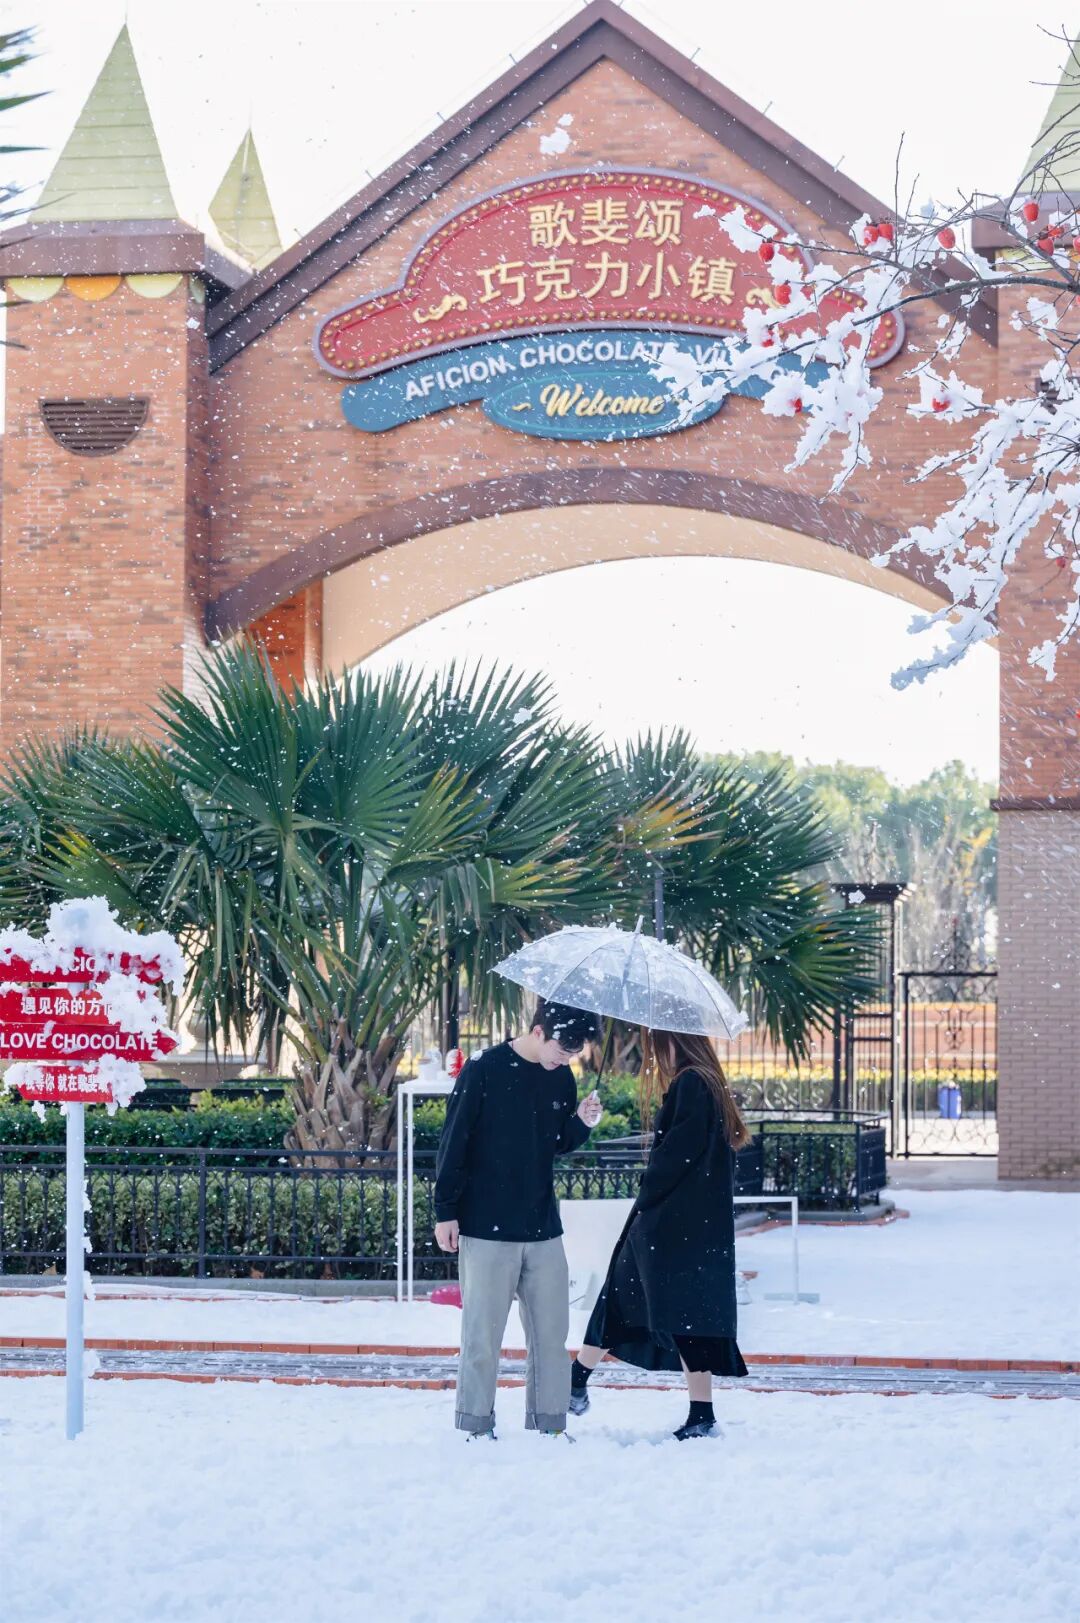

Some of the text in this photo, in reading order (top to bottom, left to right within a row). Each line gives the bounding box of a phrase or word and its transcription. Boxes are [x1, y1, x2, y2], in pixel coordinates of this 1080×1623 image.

[528, 199, 684, 248] 歌斐颂
[477, 250, 738, 306] 巧克力小镇
[405, 354, 508, 401] AFICION
[539, 383, 665, 417] Welcome
[0, 1032, 158, 1050] LOVE CHOCOLATE
